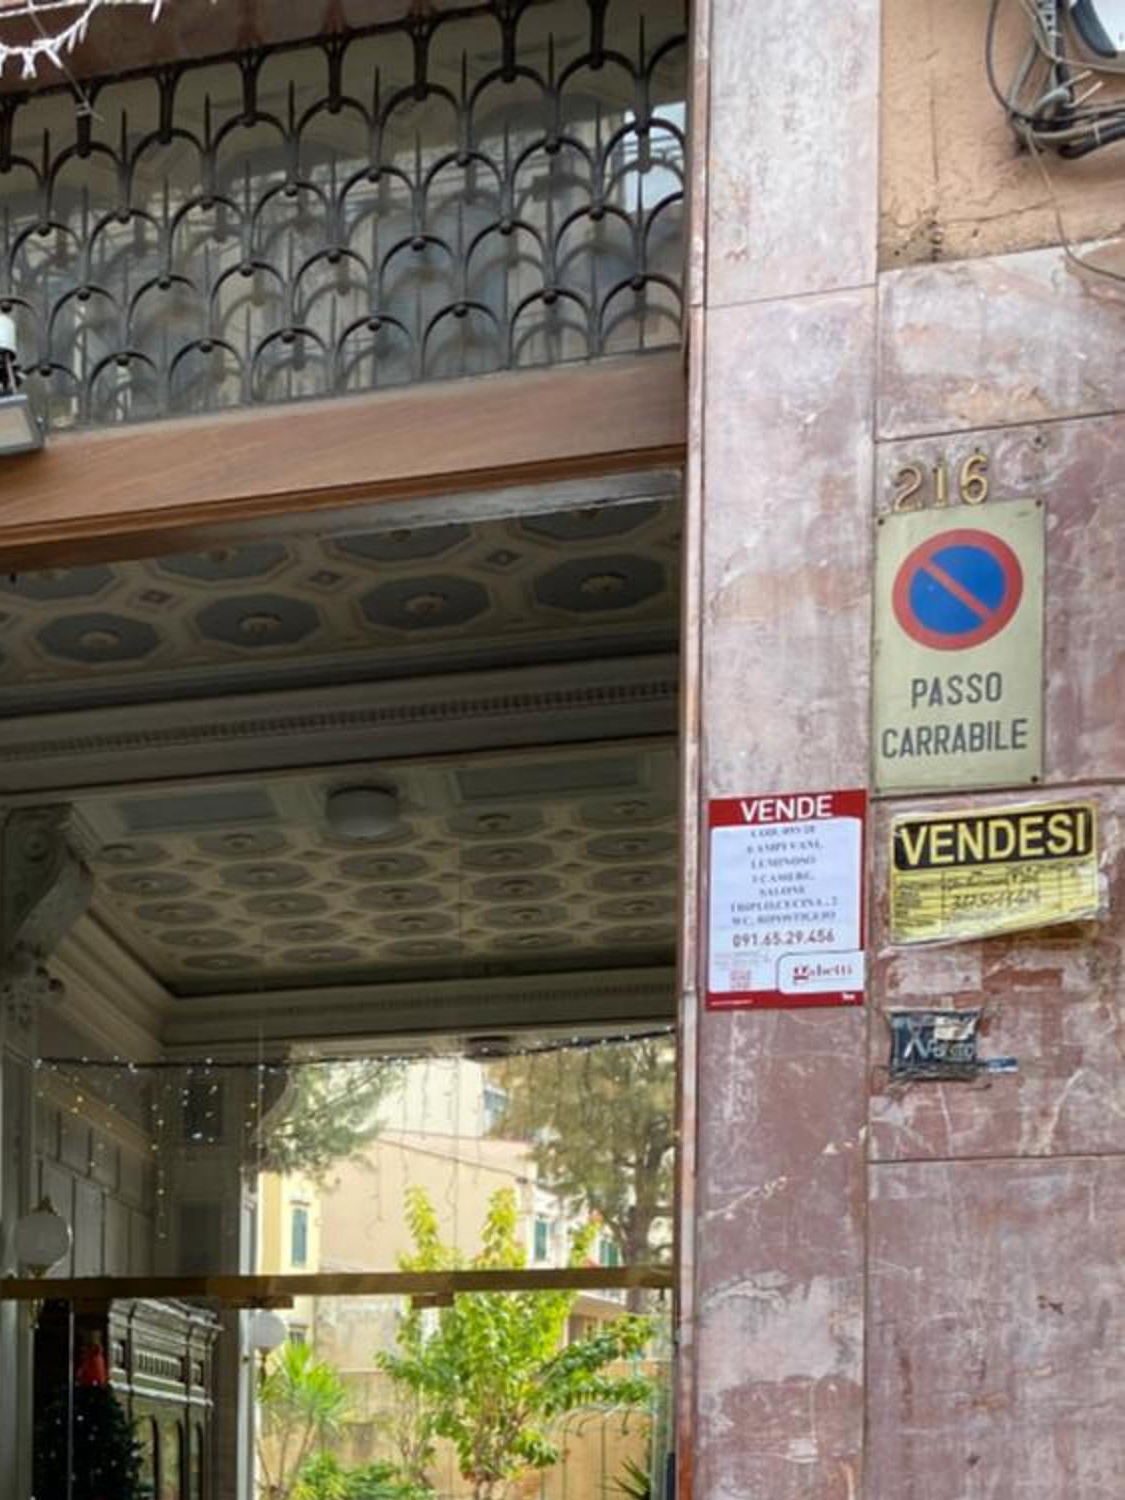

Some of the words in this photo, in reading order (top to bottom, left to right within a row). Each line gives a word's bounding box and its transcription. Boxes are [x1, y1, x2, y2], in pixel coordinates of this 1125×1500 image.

[893, 454, 988, 512] 216
[911, 672, 1003, 709] PASSO
[881, 718, 1028, 759] CARRABILE
[741, 795, 833, 823] VENDE
[899, 812, 1087, 866] VENDESI
